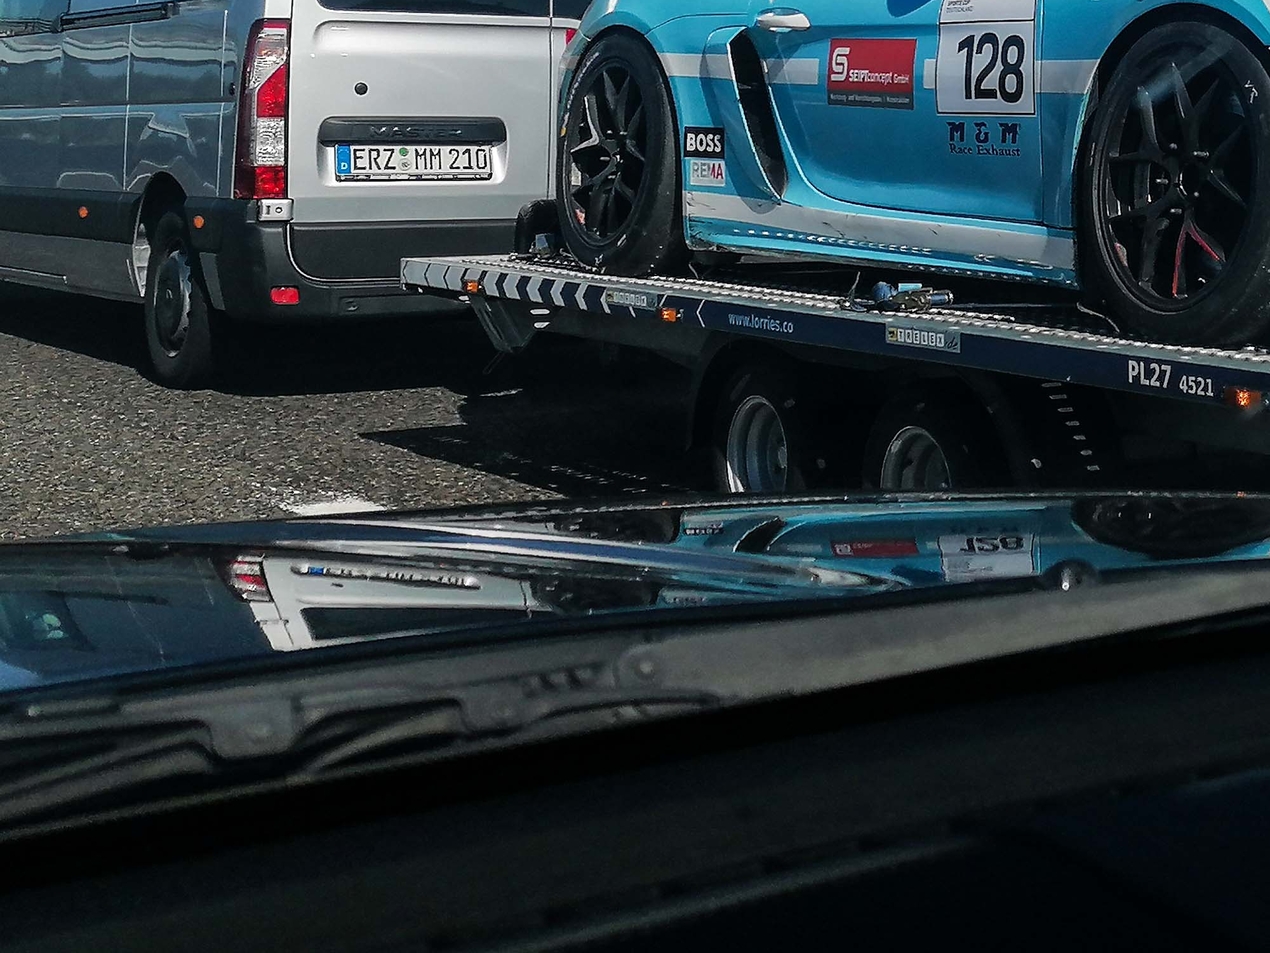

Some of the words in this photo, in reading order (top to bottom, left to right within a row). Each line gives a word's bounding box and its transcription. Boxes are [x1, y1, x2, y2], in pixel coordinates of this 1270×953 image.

[956, 32, 1026, 104] 128
[686, 133, 722, 153] BOSS
[945, 121, 965, 144] M
[974, 121, 990, 144] &
[998, 122, 1021, 145] M
[353, 148, 397, 171] ERZ
[414, 148, 442, 171] MM
[448, 148, 488, 170] 210
[948, 143, 973, 155] Race
[976, 145, 1021, 157] Exhaust
[728, 312, 795, 334] www.lorries.co
[1127, 359, 1172, 389] PL27
[1179, 374, 1214, 397] 4521
